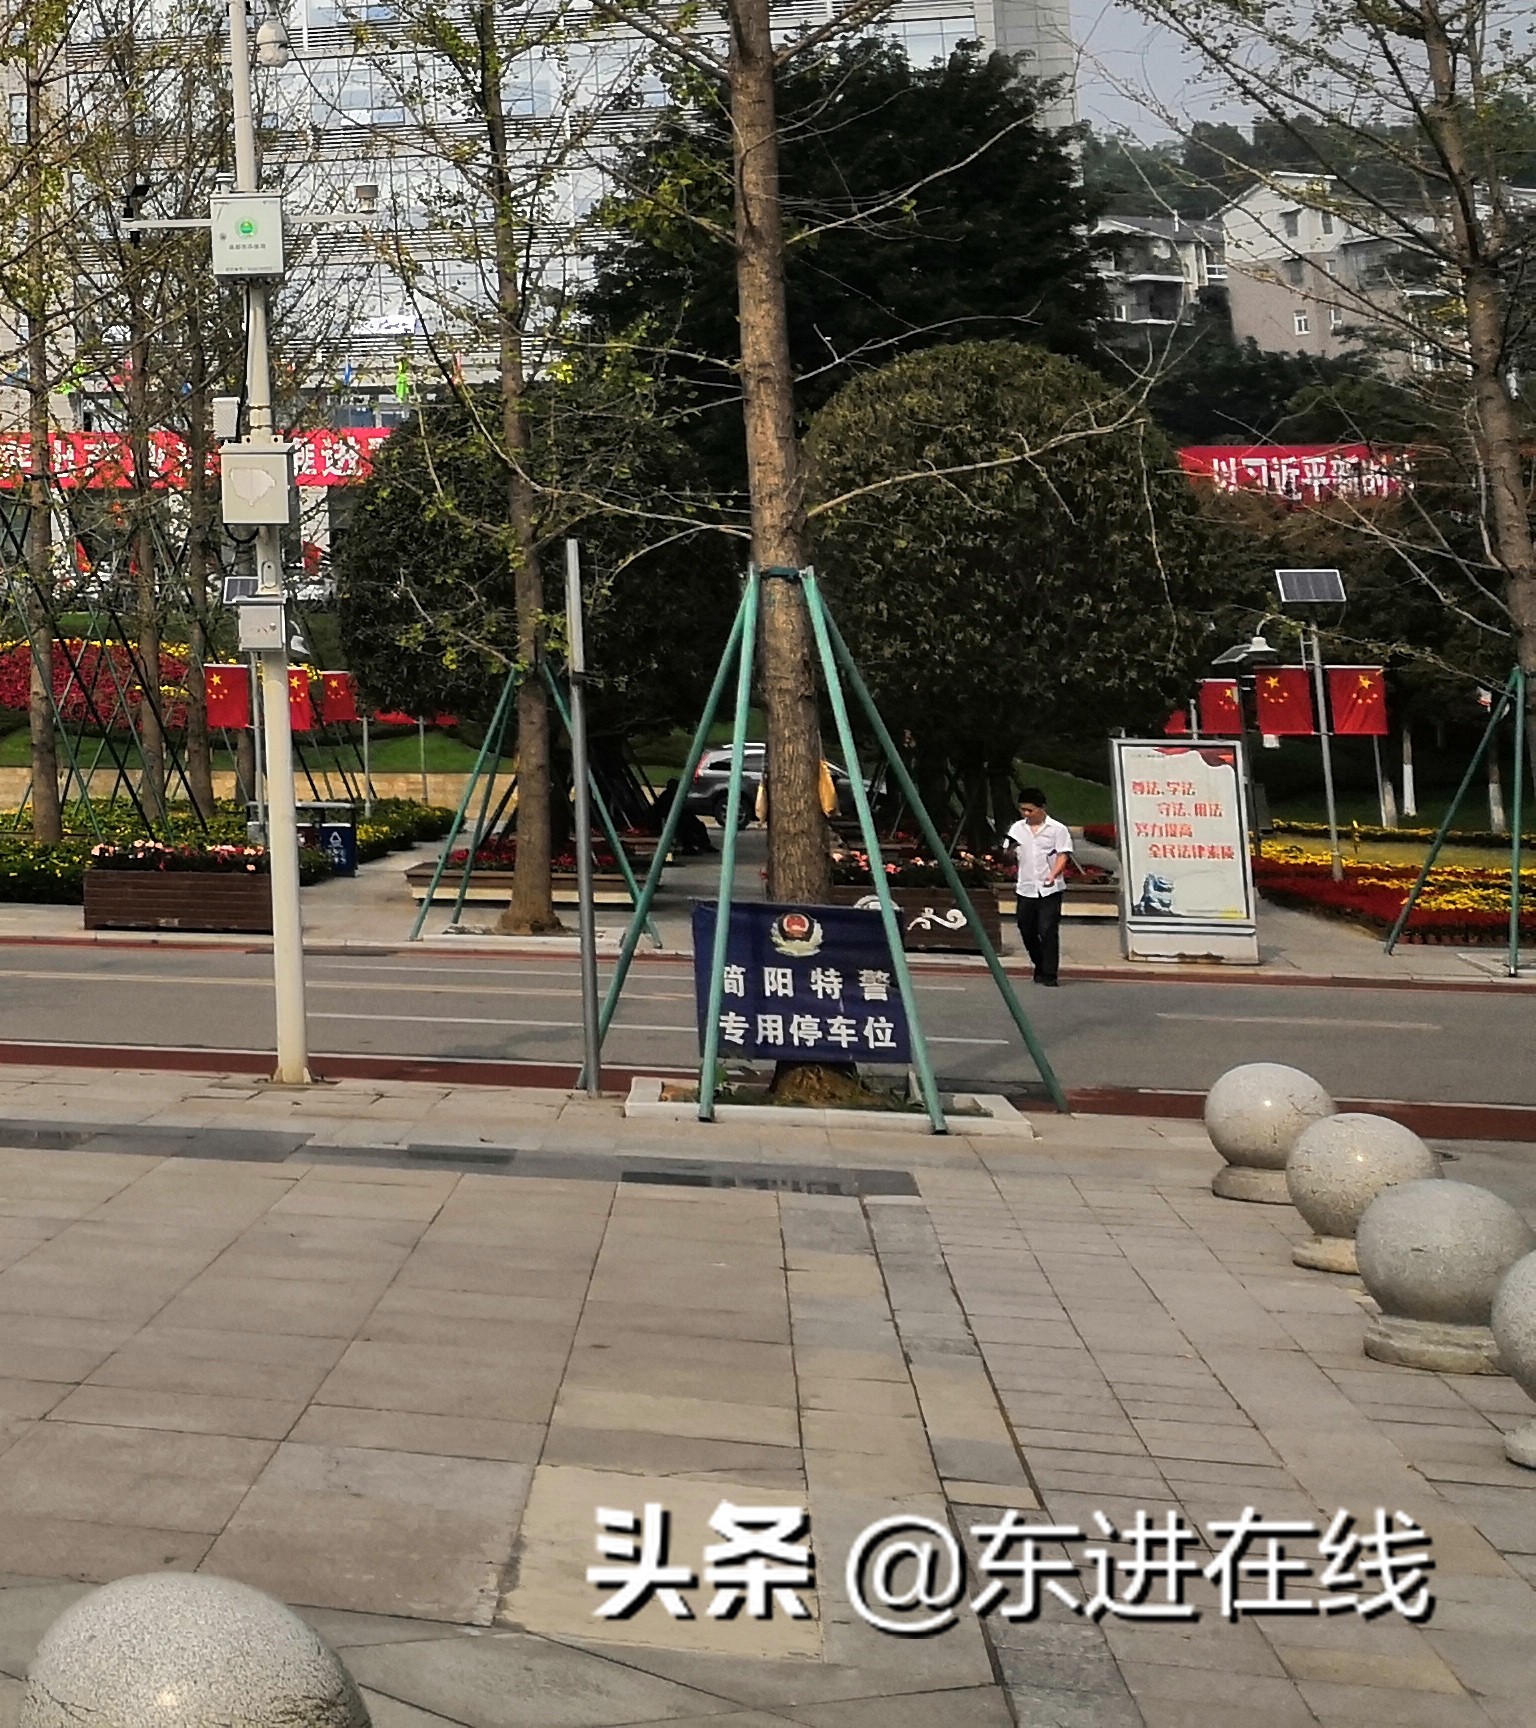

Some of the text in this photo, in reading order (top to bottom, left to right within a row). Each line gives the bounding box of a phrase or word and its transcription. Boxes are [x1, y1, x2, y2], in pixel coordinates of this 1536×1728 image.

[1134, 822, 1193, 838] 努力提高
[723, 964, 892, 1001] 简阳特警
[719, 1011, 897, 1049] 专用停车位
